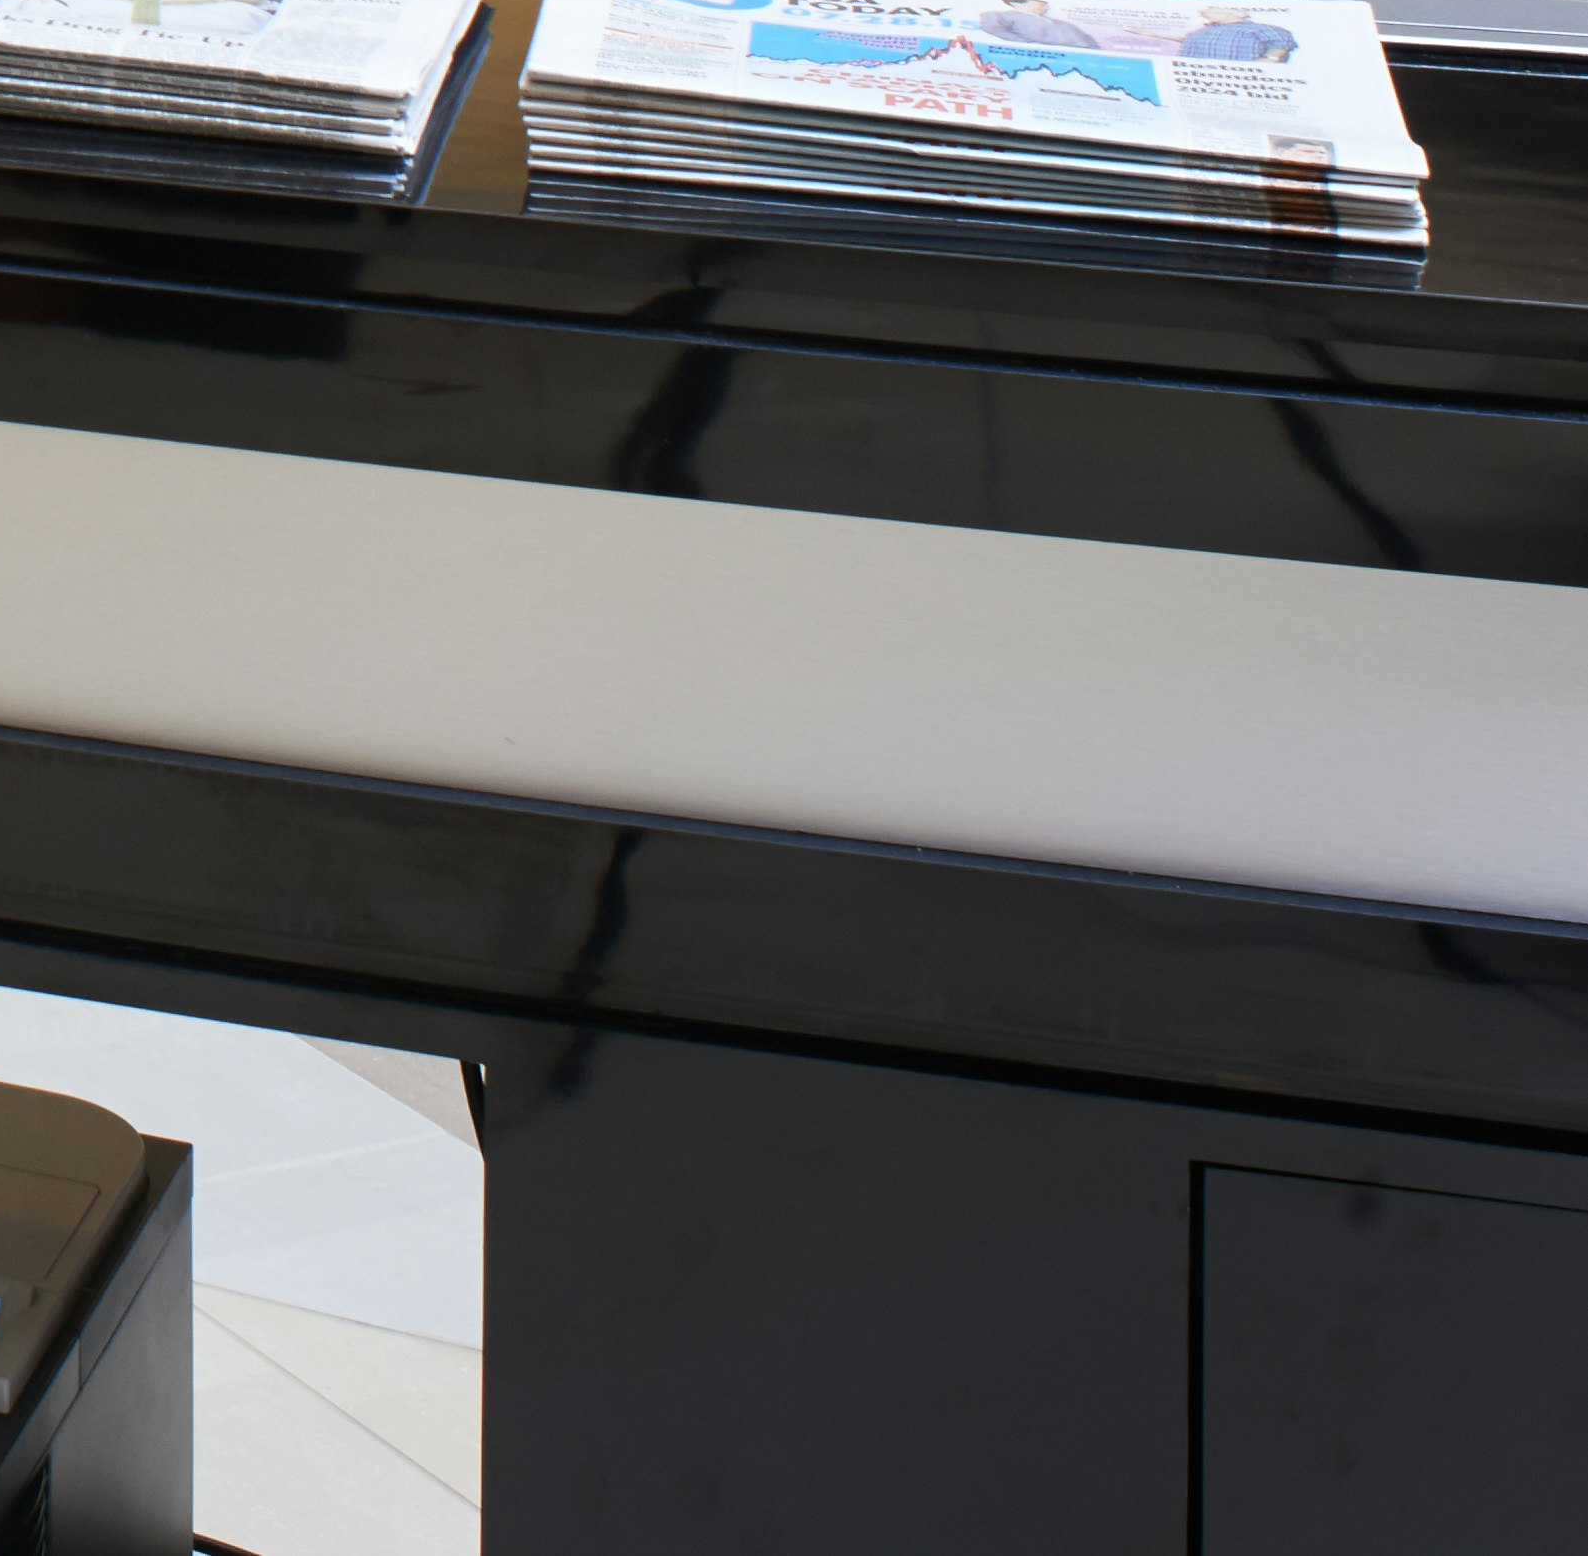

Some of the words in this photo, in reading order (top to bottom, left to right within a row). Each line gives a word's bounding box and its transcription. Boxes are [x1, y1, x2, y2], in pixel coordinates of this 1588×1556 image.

[1172, 61, 1263, 72] Boston
[1173, 71, 1307, 84] abandons
[1174, 77, 1293, 91] Olympics
[1177, 86, 1239, 97] 2024
[1246, 90, 1289, 100] bid
[885, 94, 1012, 120] PATH
